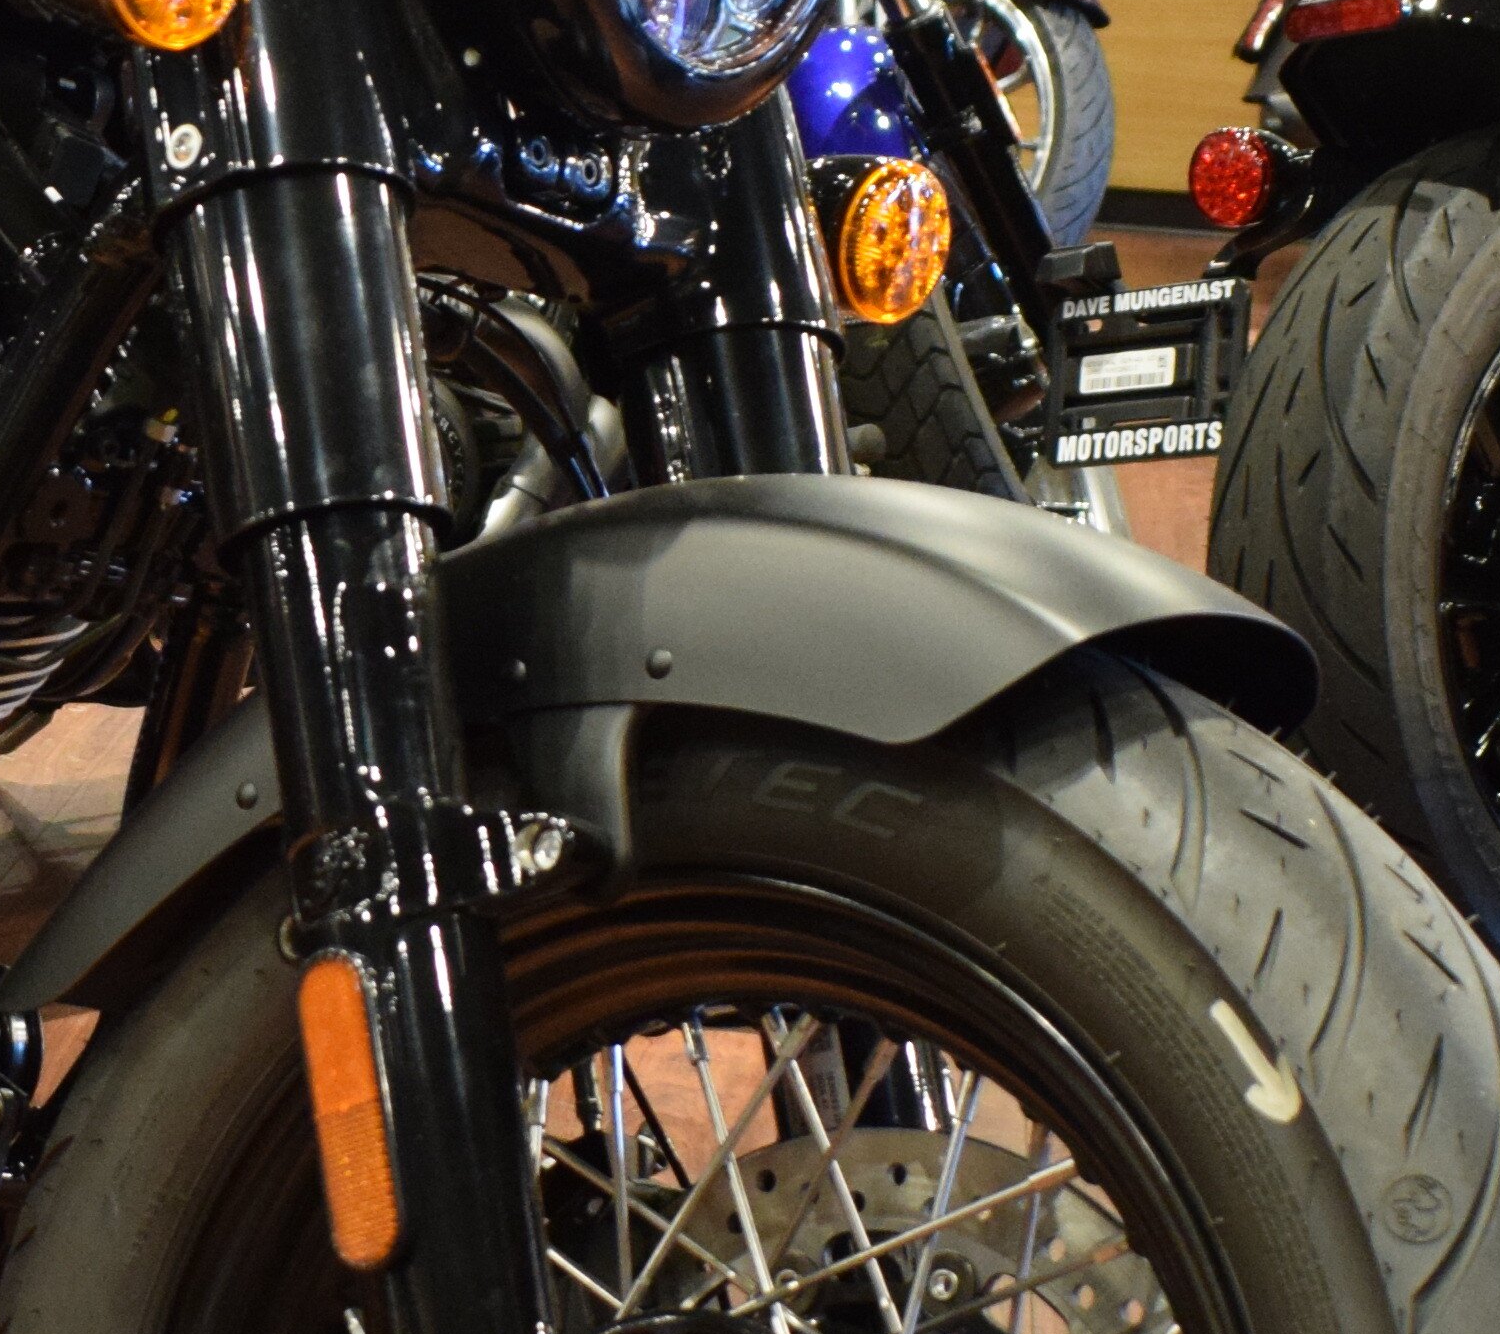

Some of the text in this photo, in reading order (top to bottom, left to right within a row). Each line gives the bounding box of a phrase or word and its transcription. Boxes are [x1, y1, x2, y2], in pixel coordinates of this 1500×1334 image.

[1062, 278, 1237, 319] DAVE MUNGENAST
[1055, 420, 1224, 464] MOTORSPORTS
